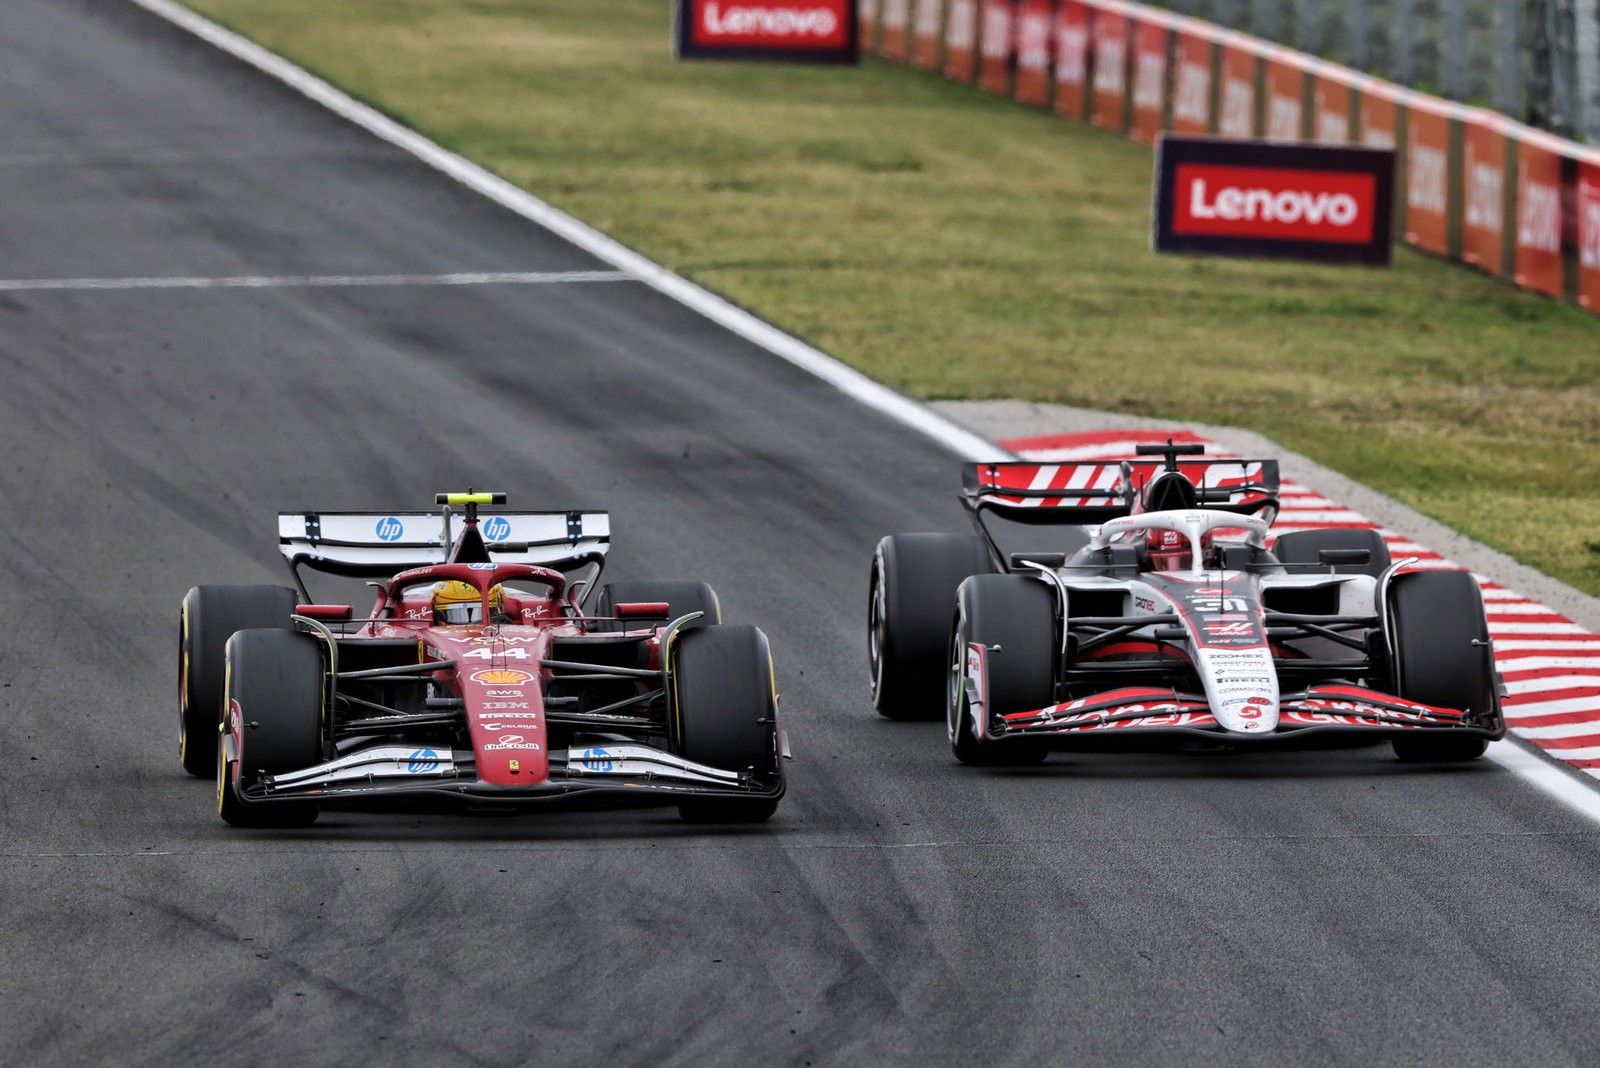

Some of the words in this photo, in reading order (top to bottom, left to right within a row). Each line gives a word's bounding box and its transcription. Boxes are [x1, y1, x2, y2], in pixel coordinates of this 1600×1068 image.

[704, 3, 839, 37] Lenovo
[1190, 178, 1358, 226] Lenovo
[379, 517, 402, 541] hp
[486, 517, 510, 541] hp
[462, 647, 531, 660] 44
[486, 689, 524, 698] aws
[482, 701, 530, 709] IBM
[484, 742, 540, 750] UniCredit
